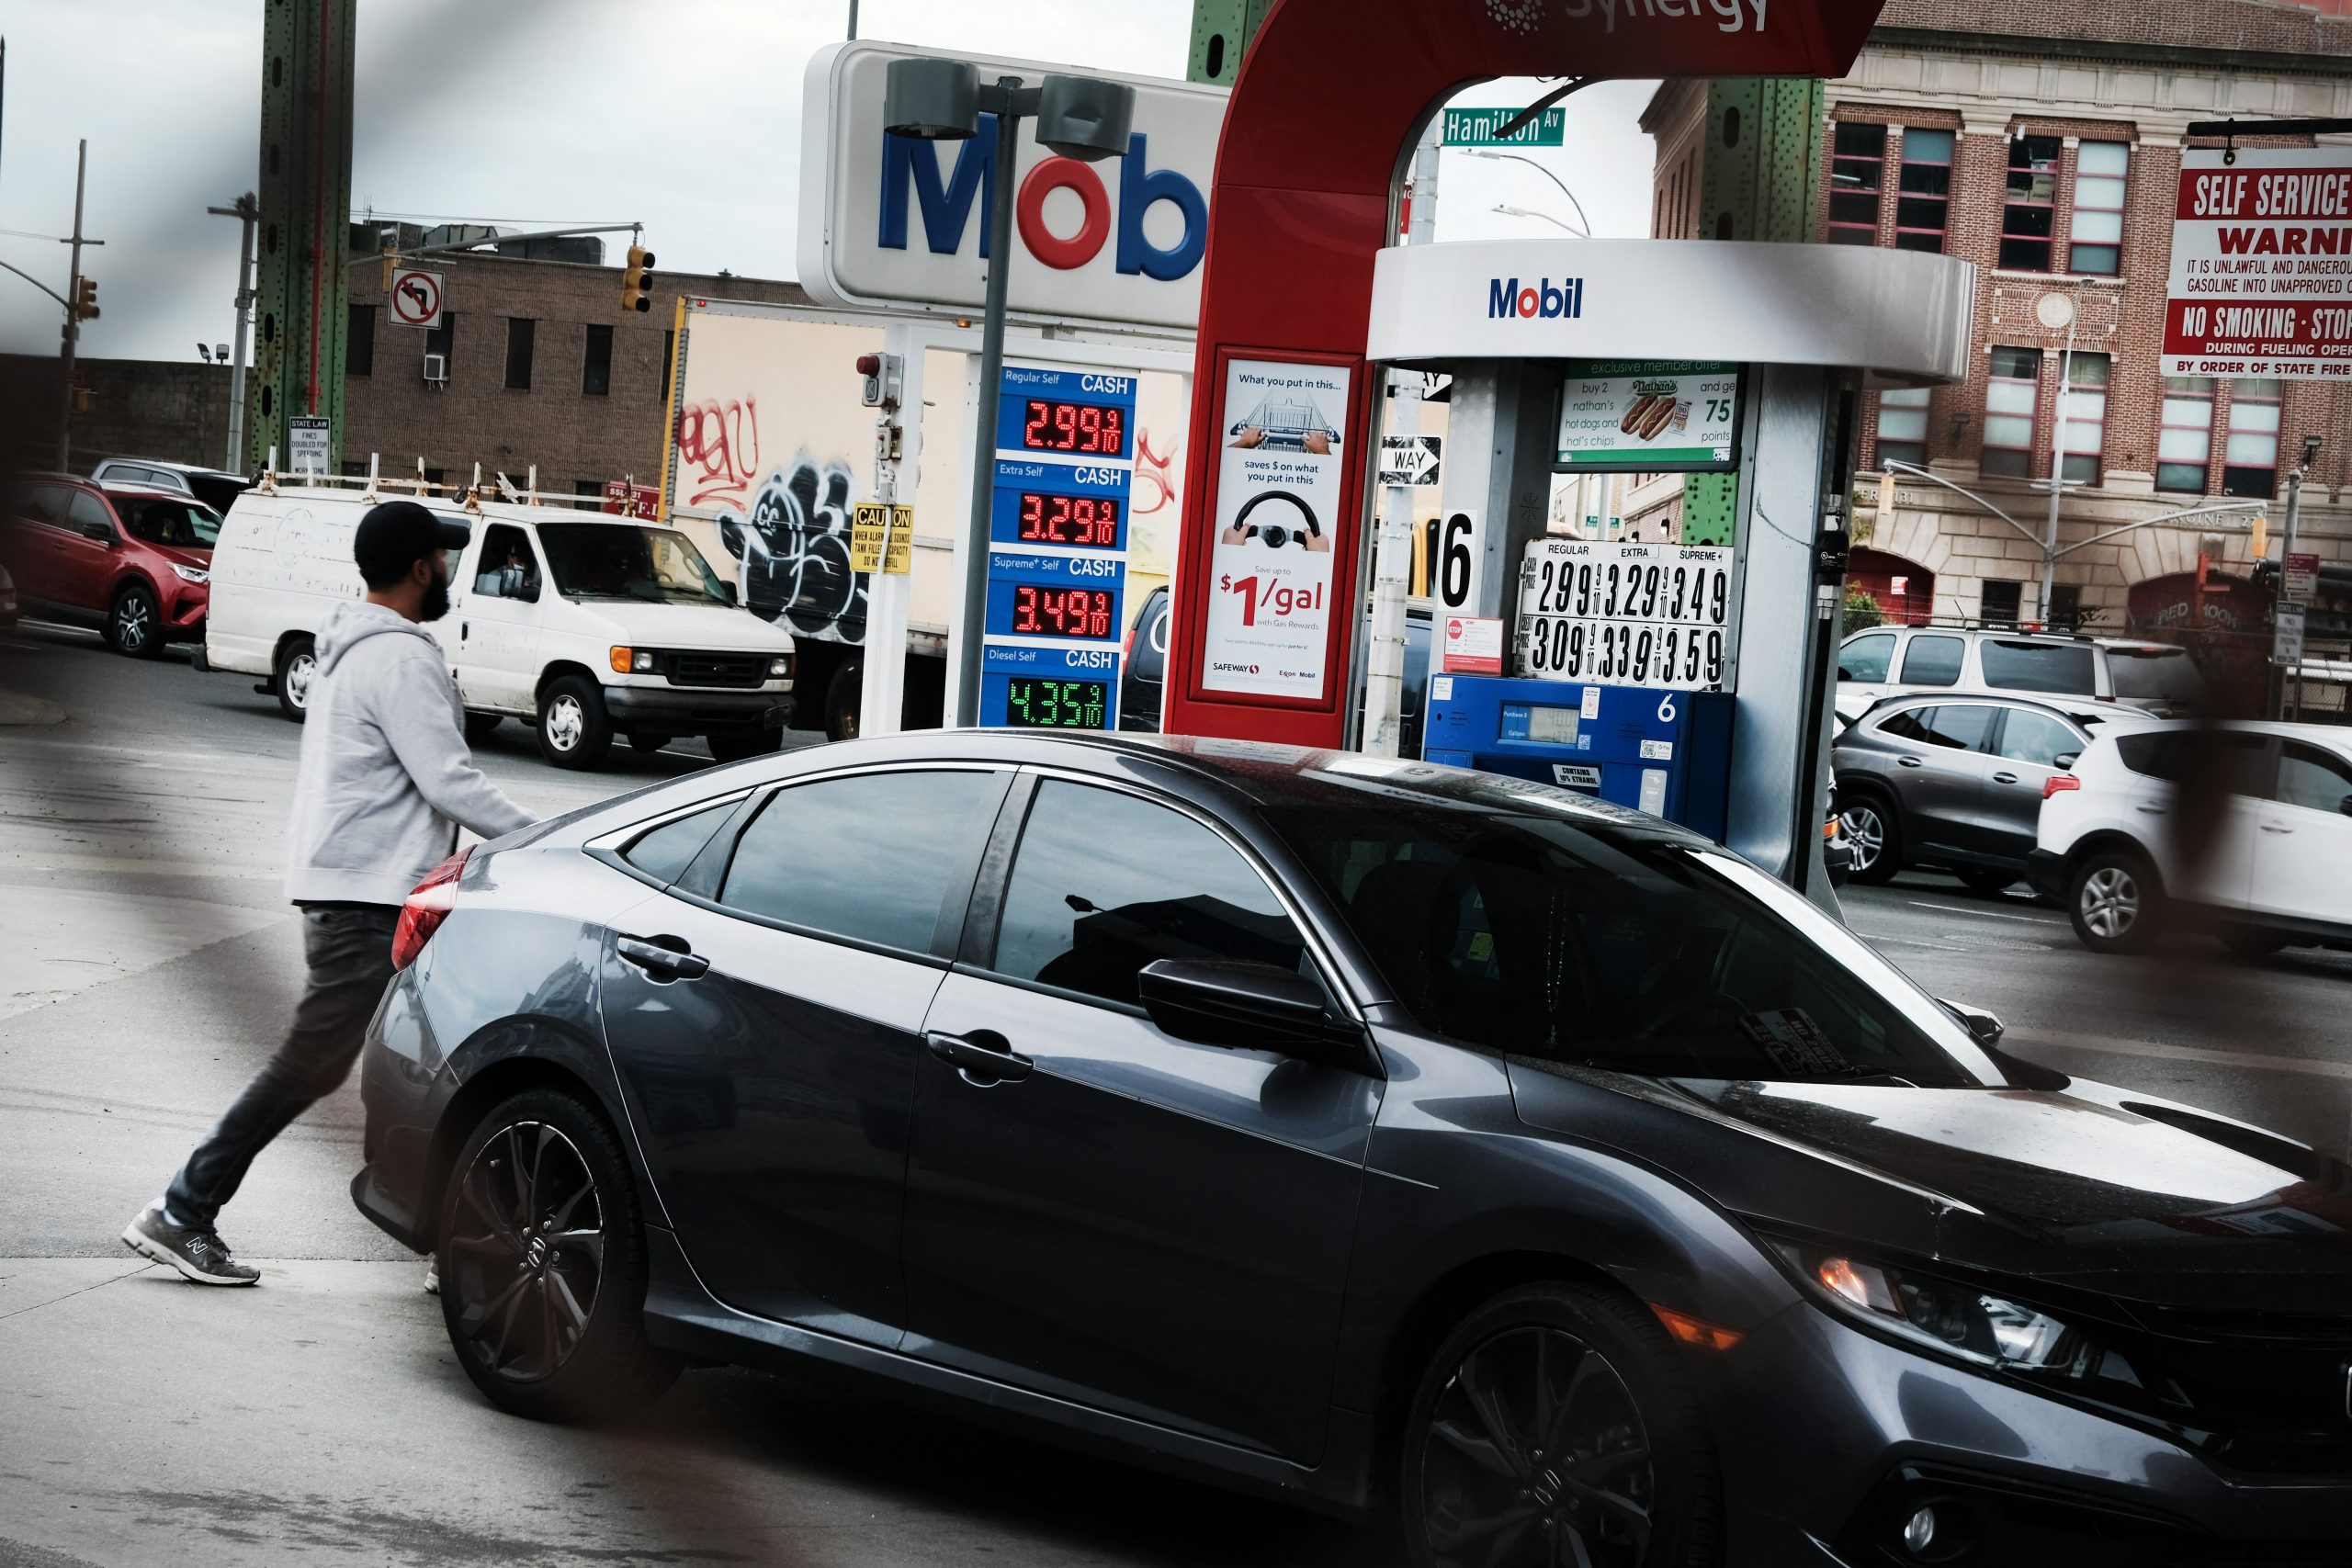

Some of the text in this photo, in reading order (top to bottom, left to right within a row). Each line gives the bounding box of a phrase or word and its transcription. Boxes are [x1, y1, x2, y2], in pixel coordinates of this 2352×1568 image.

[1544, 110, 1559, 128] Av
[2194, 174, 2351, 216] SELF SERVICE
[2187, 259, 2197, 274] IT
[2199, 260, 2210, 274] IS
[2214, 260, 2267, 274] UNLAWFUL
[2272, 260, 2293, 275] AND
[2188, 277, 2237, 293] GASOLINE
[2243, 278, 2267, 293] INTO
[2271, 278, 2342, 294] UNAPPROVED
[1488, 277, 1584, 319] Mobil
[2182, 306, 2207, 338] NO
[2213, 307, 2296, 339] SMOKING
[2205, 342, 2256, 355] DURING
[2260, 343, 2315, 355] FUELING
[1591, 361, 1641, 374] exclusive
[1644, 360, 1692, 372] member
[2177, 360, 2351, 376] BY ORDER OF STATE FIRE
[1005, 370, 1128, 395] Regular Self CASH
[1238, 374, 1265, 385] What
[1267, 378, 1284, 388] you
[1286, 378, 1303, 389] put
[1305, 378, 1314, 389] in
[1581, 382, 1608, 394] buy 2
[1700, 382, 1719, 392] and
[1573, 400, 1614, 412] nathan's
[1706, 399, 1731, 423] 75
[1026, 402, 1101, 451] 2.99
[1565, 417, 1619, 431] hot dogs and
[1566, 435, 1614, 447] hal's chips
[1702, 432, 1730, 443] points
[1245, 460, 1318, 473] saves $ on what
[1395, 451, 1426, 469] WAY
[312, 467, 324, 475] ONE
[1000, 464, 1122, 486] Extra Self CASH
[1248, 473, 1314, 485] you put in this
[857, 508, 910, 527] CAUON
[1022, 495, 1094, 543] 3.29
[854, 531, 867, 540] WHEN
[893, 533, 910, 544] SOUNDS
[854, 543, 866, 553] TANK
[1548, 544, 1716, 561] REGULAR EXTRA SUPREME
[864, 556, 870, 566] DO
[1041, 559, 1059, 571] Self
[1069, 558, 1116, 577] CASH
[1442, 513, 1472, 607] 6
[1254, 565, 1272, 573] Save
[1272, 568, 1282, 576] up
[1539, 560, 1591, 616] 2.99
[1604, 563, 1660, 617] 3.29
[1670, 567, 1726, 625] 3.49
[1016, 587, 1088, 634] 3.49
[1256, 618, 1319, 630] with Gas Rewards
[1449, 626, 1462, 634] STOP
[1532, 617, 1584, 678] 3.09
[1663, 628, 1722, 682] 3.59
[989, 649, 1112, 669] Diesel Self CASH
[1213, 662, 1249, 672] SAFEWAY
[1279, 670, 1296, 678] Exxon
[1011, 682, 1081, 726] 4.35
[1657, 694, 1676, 723] 6
[1562, 767, 1590, 776] CONTAINS
[1572, 775, 1599, 784] ETHANOL
